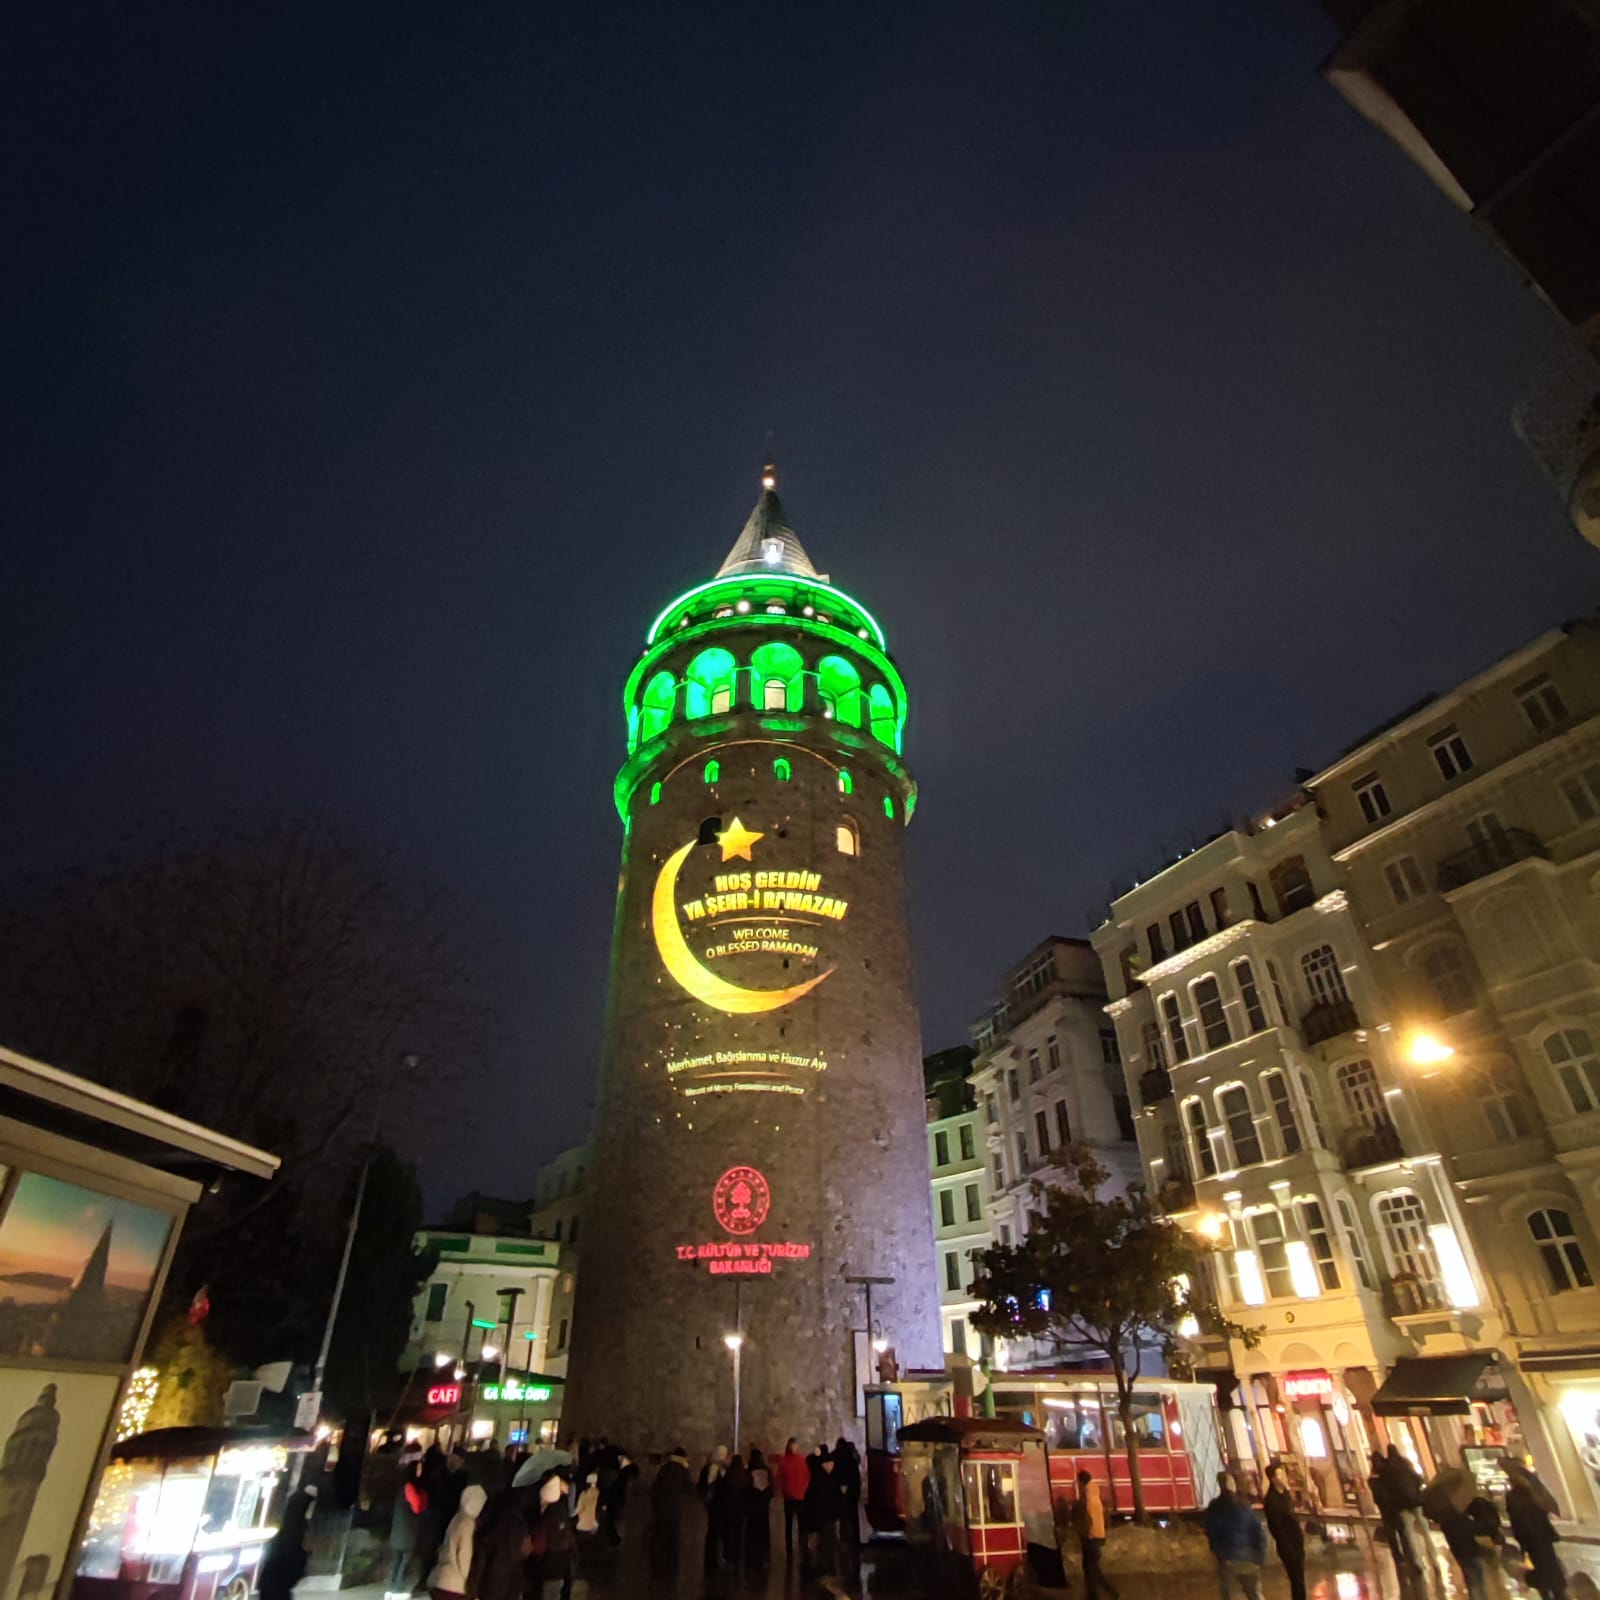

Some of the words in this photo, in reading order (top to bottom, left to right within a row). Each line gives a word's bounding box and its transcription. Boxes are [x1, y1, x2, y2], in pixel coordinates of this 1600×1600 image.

[714, 872, 752, 891] HOŞ
[755, 870, 822, 891] GELDİN
[683, 900, 706, 921] YA
[706, 889, 761, 917] ŞEHR-İ
[763, 891, 848, 920] RAMAZAN
[733, 928, 790, 940] WELCOME
[706, 947, 716, 959] O
[716, 941, 760, 956] BLESSED
[762, 941, 819, 958] RAMADAN
[768, 1053, 780, 1063] ve
[781, 1052, 810, 1068] Huzur
[810, 1058, 828, 1072] Ayı
[698, 1241, 742, 1258] KÜLTÜR
[744, 1244, 759, 1256] VE
[761, 1241, 809, 1258] TURİZM
[709, 1258, 772, 1274] BAKANLIĞI
